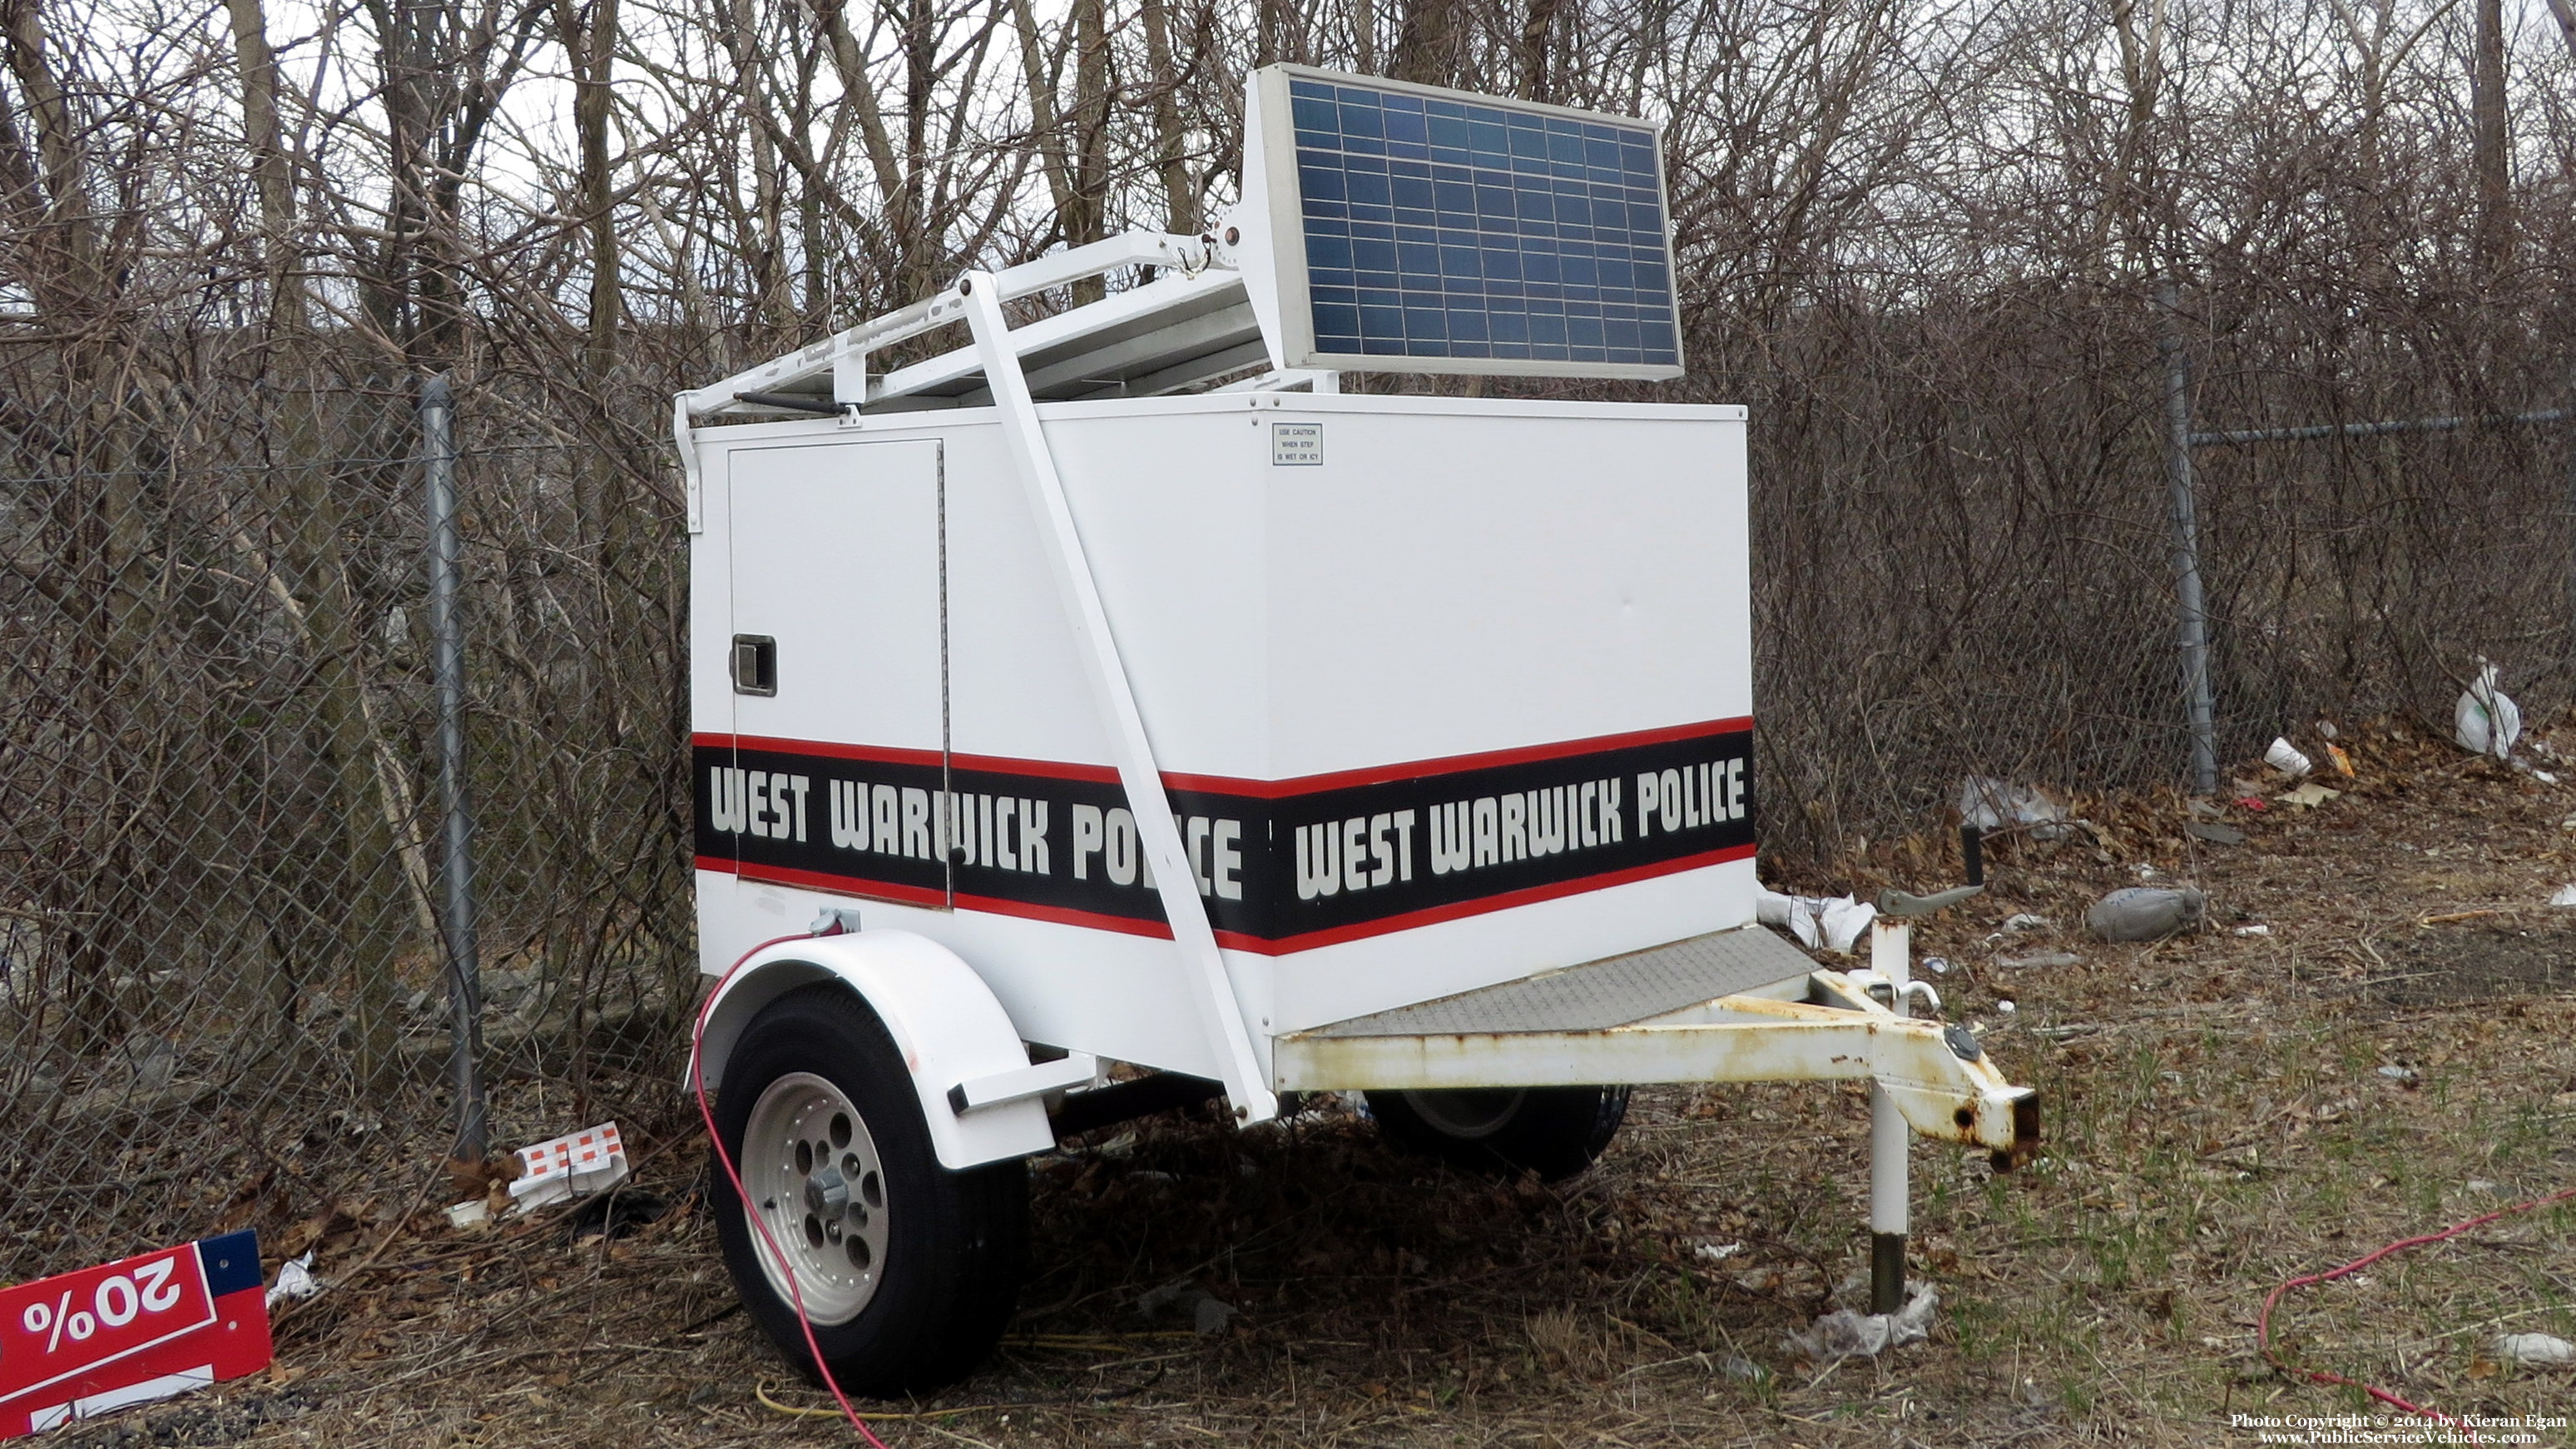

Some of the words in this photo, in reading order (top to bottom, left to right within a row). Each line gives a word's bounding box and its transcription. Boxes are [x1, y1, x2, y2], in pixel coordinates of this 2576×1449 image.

[711, 766, 810, 842] WEST
[830, 778, 1051, 876] WARWICK
[1072, 803, 1242, 901] POCE
[1295, 808, 1415, 901] WEST
[1429, 777, 1623, 876] WARWICK
[1637, 757, 1746, 838] POLICE
[22, 1255, 181, 1354] 20%
